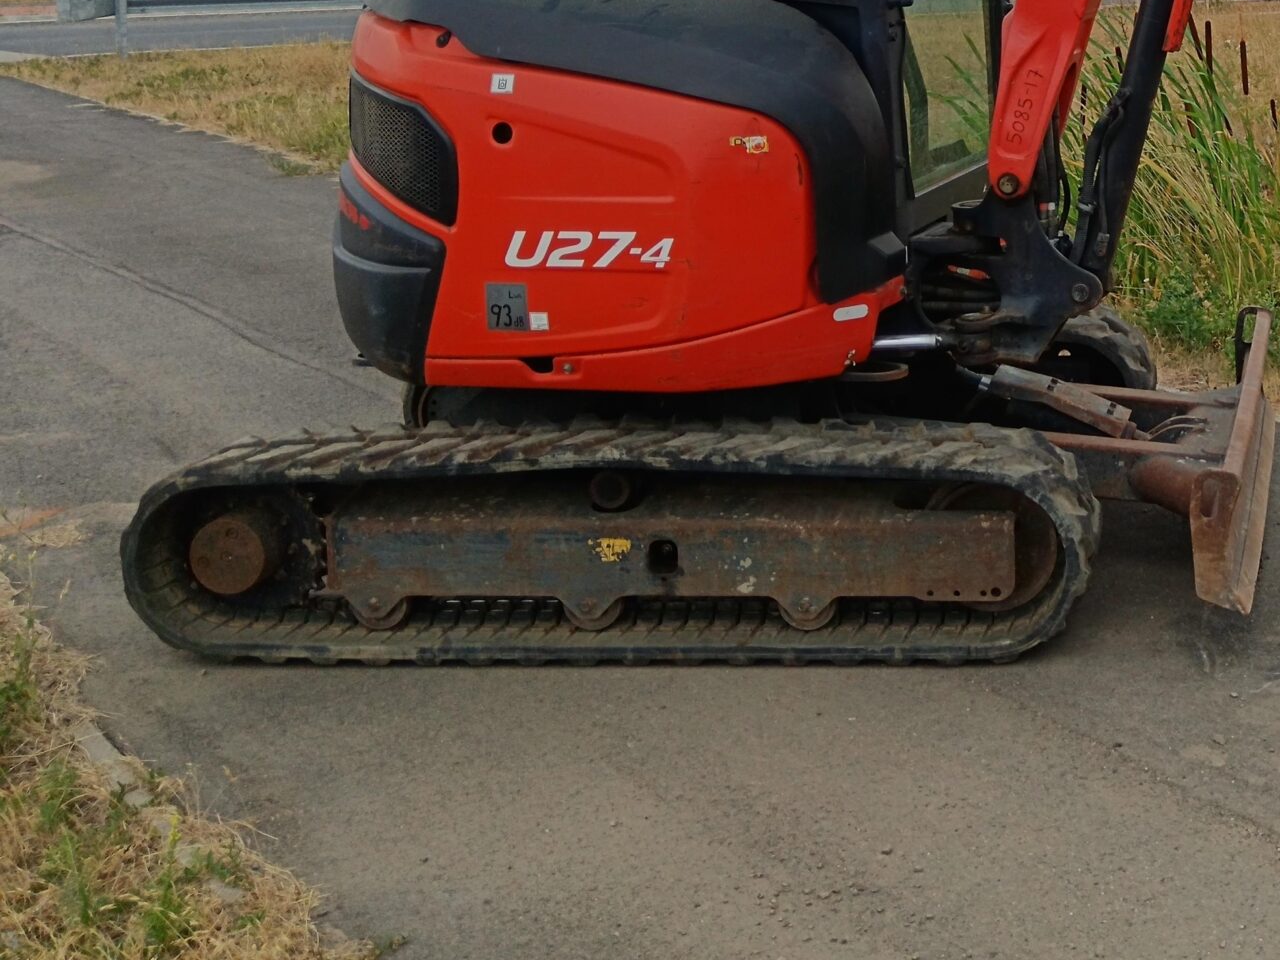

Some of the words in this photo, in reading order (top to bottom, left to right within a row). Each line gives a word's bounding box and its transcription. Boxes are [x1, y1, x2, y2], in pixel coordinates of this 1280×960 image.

[1006, 68, 1044, 145] 5085-17
[504, 230, 675, 269] U27-4
[490, 303, 513, 328] 93
